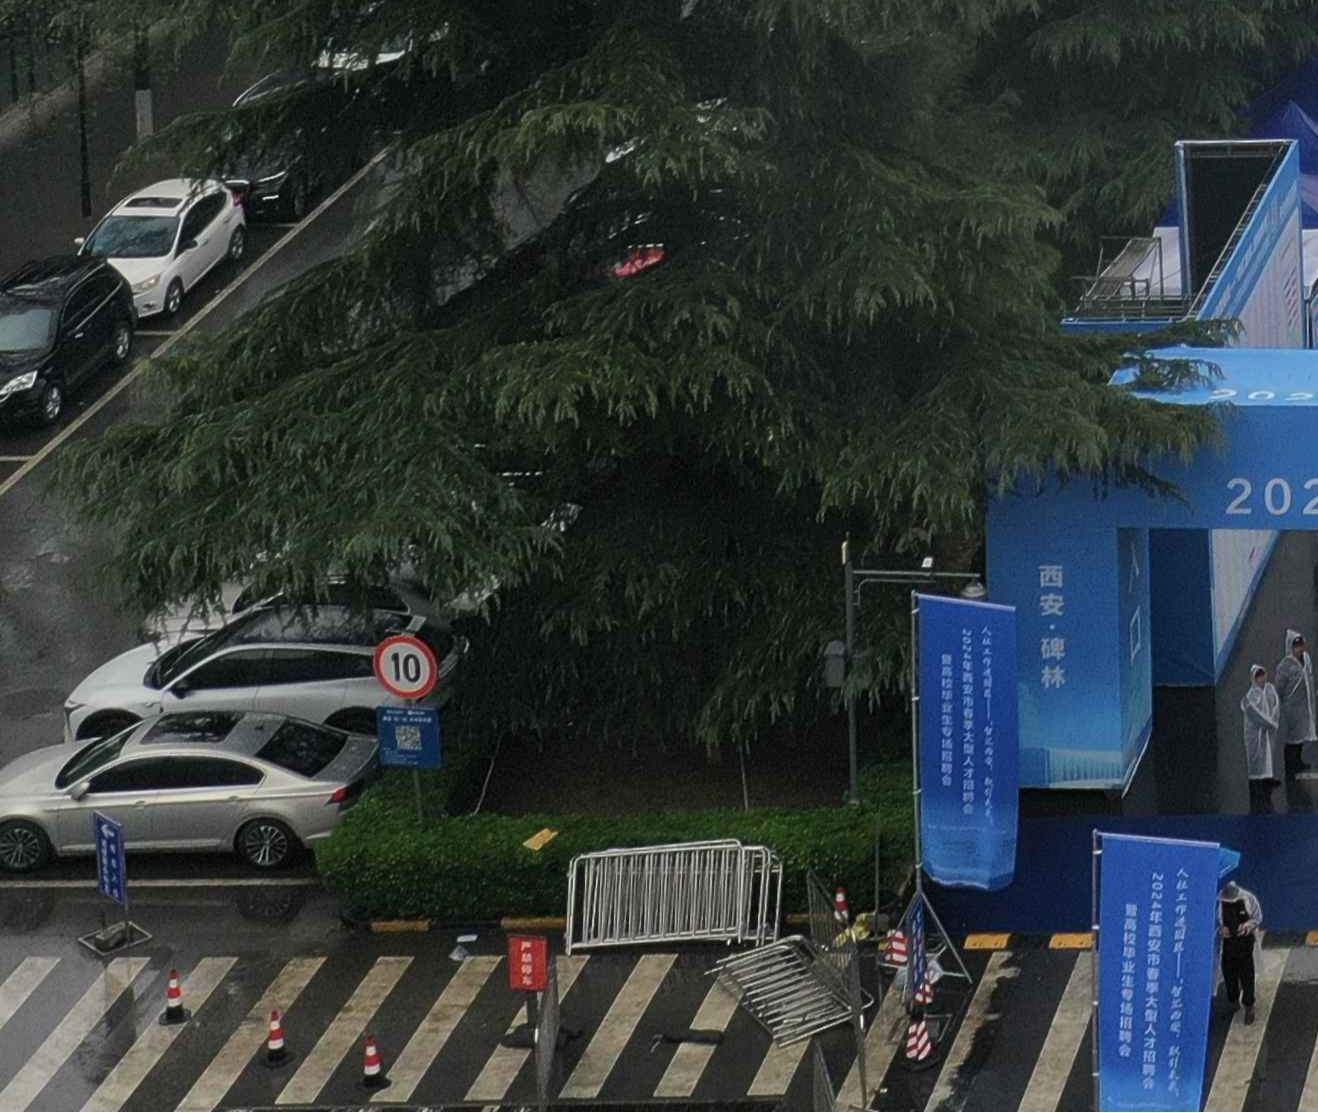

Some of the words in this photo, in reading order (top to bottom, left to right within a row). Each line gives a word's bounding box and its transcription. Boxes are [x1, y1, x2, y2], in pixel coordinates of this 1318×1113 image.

[390, 652, 420, 685] 10
[1039, 565, 1066, 689] 西安·碑林
[1118, 904, 1138, 1057] 暨高校毕业生专场招聘会
[1143, 873, 1164, 1090] 2024年西安市春季大型人才招聘会
